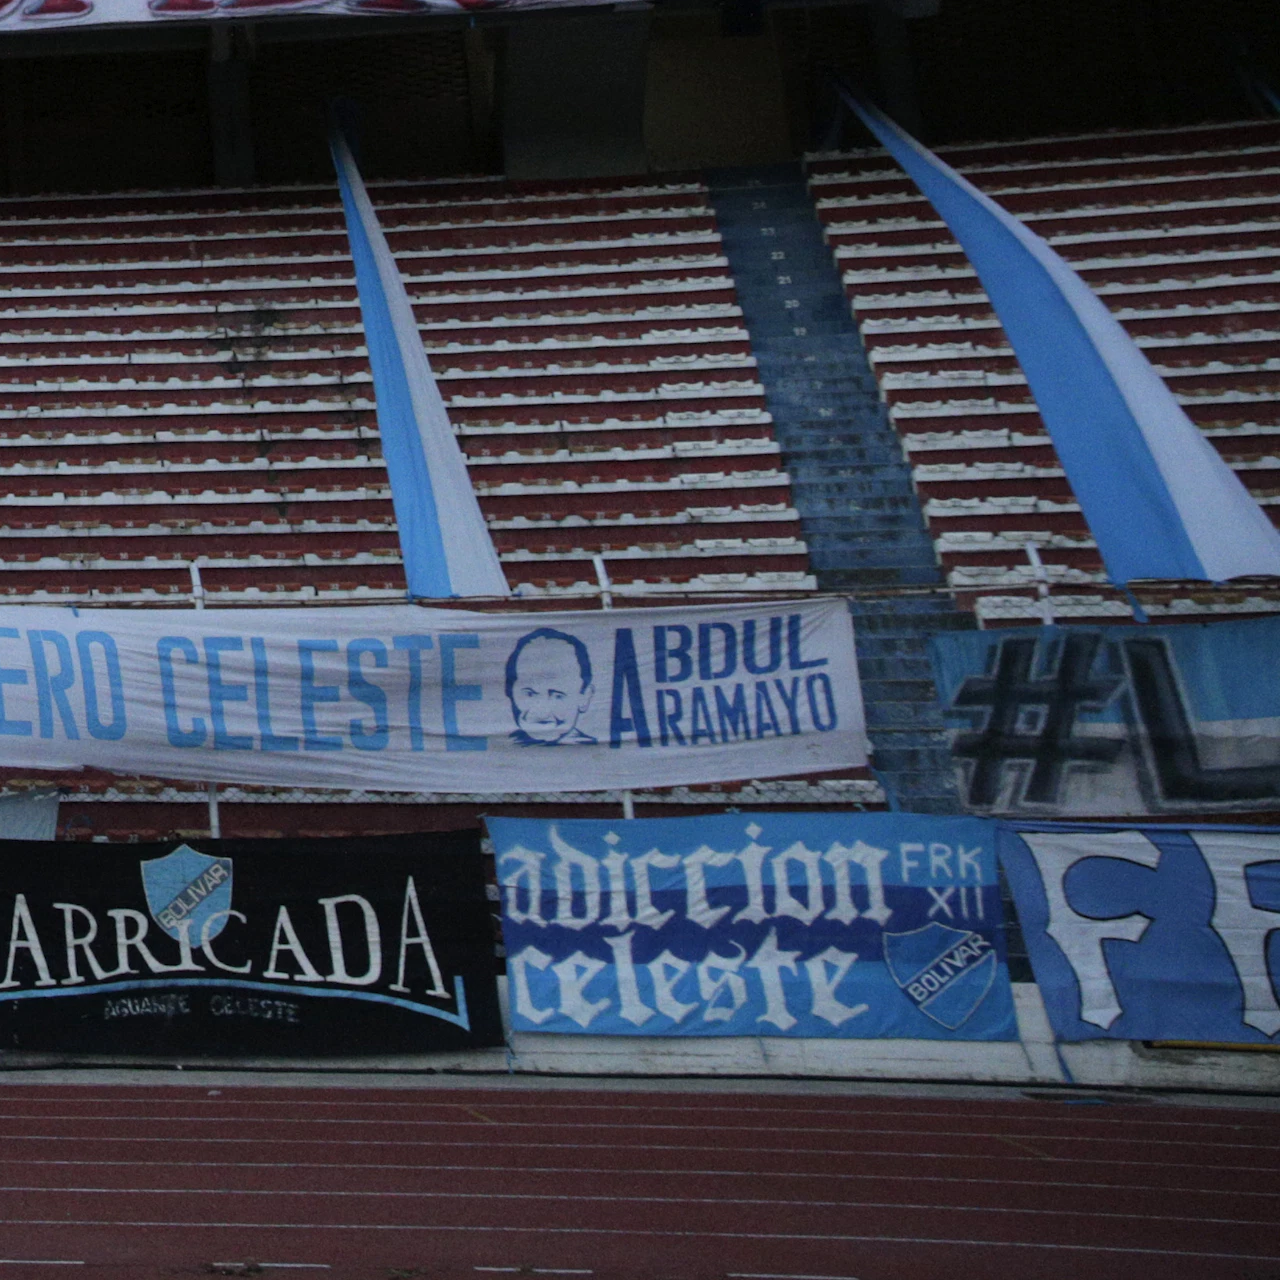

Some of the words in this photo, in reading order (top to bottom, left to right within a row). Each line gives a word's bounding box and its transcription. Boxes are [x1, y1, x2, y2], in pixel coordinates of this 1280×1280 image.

[156, 634, 488, 752] CELESTE
[157, 861, 230, 929] BOLIVAR
[899, 841, 984, 884] FRK
[926, 884, 986, 920] XII
[507, 926, 871, 1032] celeste
[905, 930, 992, 1008] BOLIVAR
